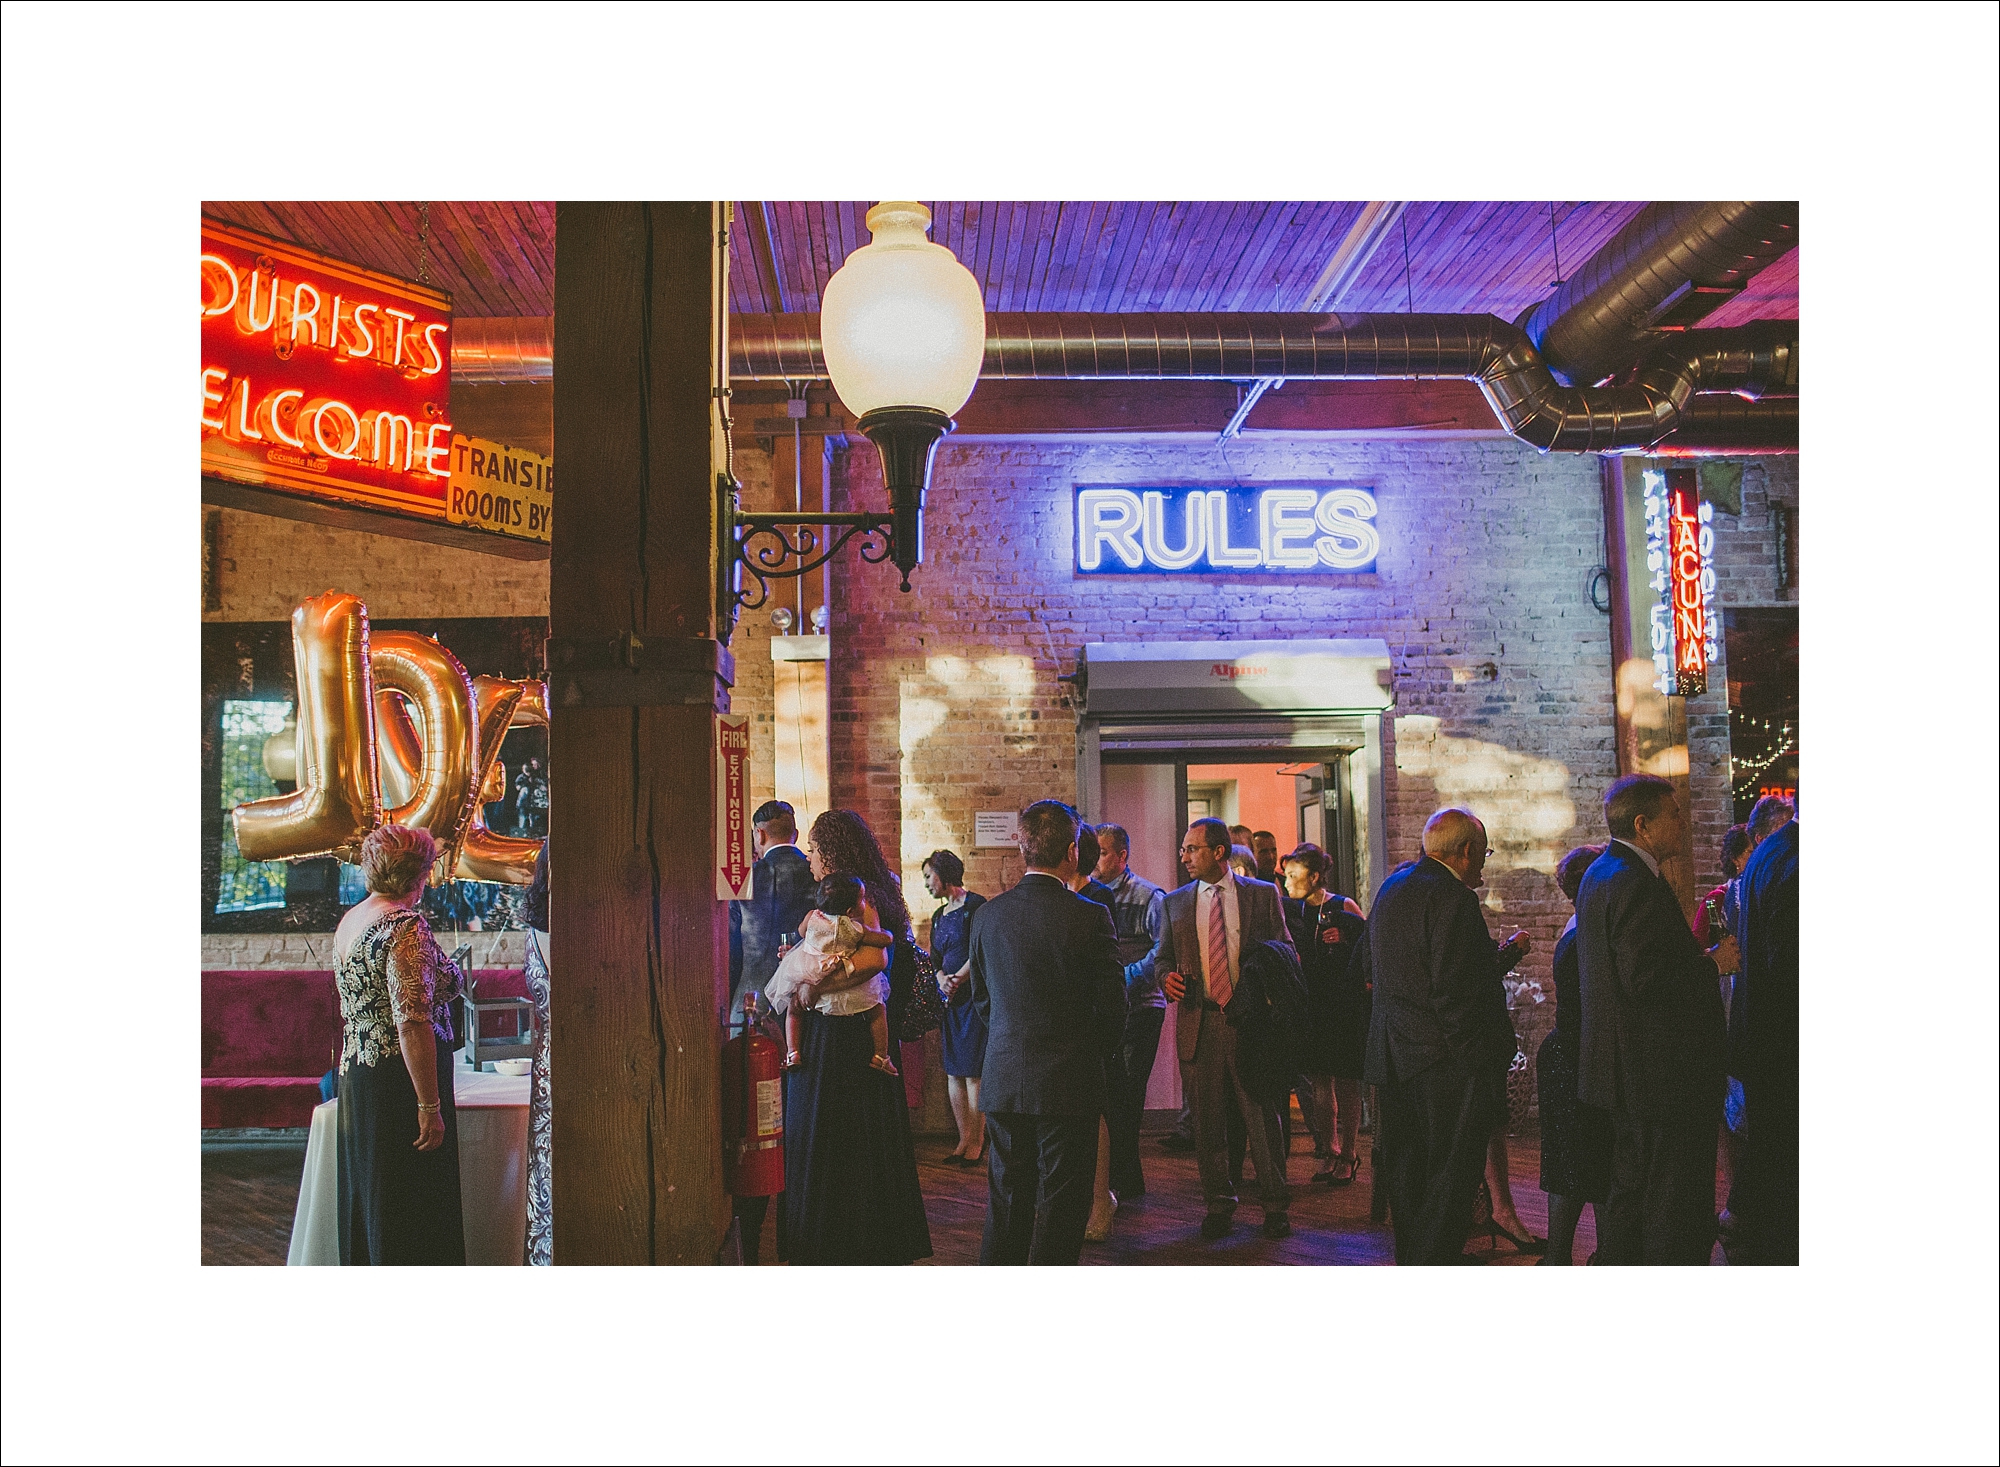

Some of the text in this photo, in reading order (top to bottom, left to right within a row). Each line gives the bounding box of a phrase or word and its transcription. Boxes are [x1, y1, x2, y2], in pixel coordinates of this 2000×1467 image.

[200, 367, 452, 477] ELCOME
[452, 486, 551, 533] ROOMS BY
[1078, 488, 1380, 570] RULES
[1675, 488, 1703, 670] LACUNA
[722, 730, 748, 749] FIRE
[729, 754, 742, 886] EXTINGUISHER
